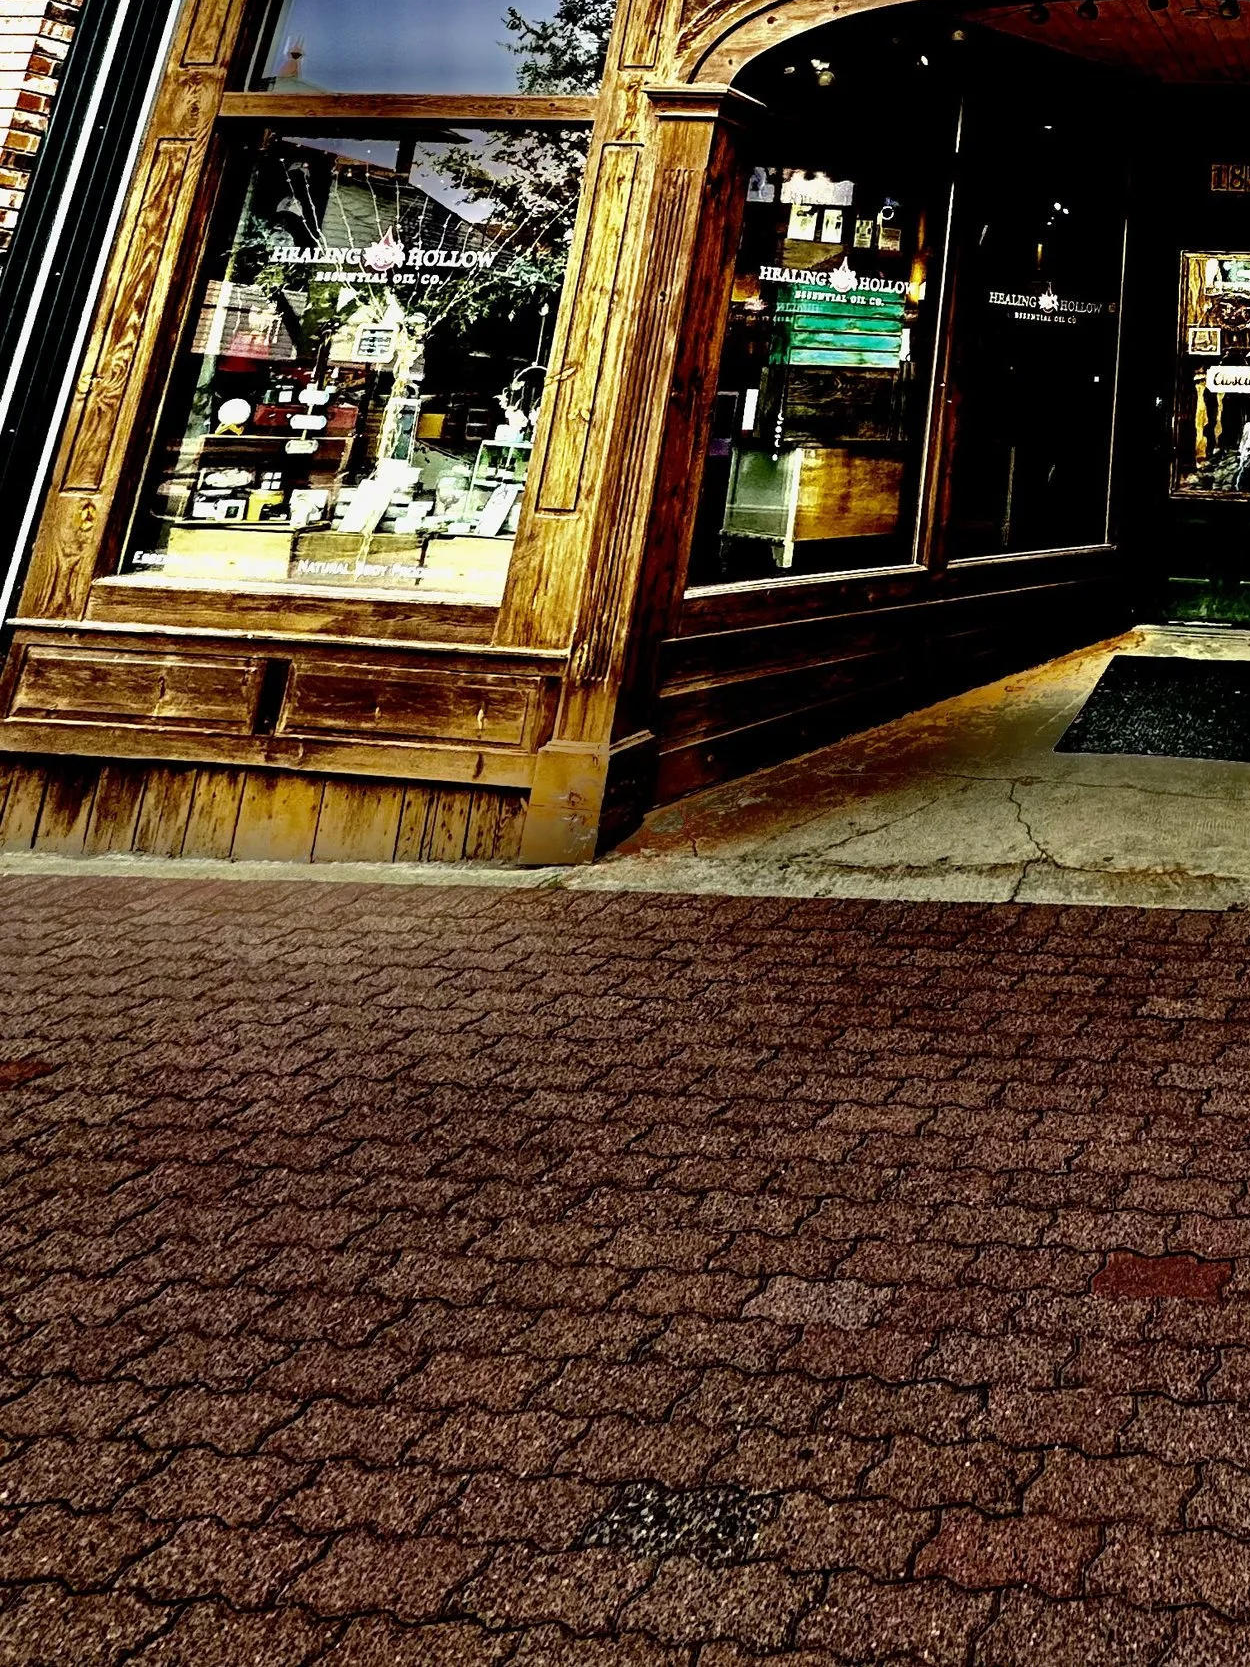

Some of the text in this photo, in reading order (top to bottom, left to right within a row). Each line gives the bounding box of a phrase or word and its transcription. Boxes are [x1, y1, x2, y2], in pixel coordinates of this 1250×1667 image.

[269, 246, 500, 268] HEALING HOLLOW
[314, 271, 444, 285] ESSENTIAL OIL CO.
[758, 265, 828, 287] HEALING
[794, 290, 885, 307] ESSENTIAL OIL CO.
[988, 291, 1103, 314] HEALING HOLLOW
[1053, 315, 1065, 323] OIL
